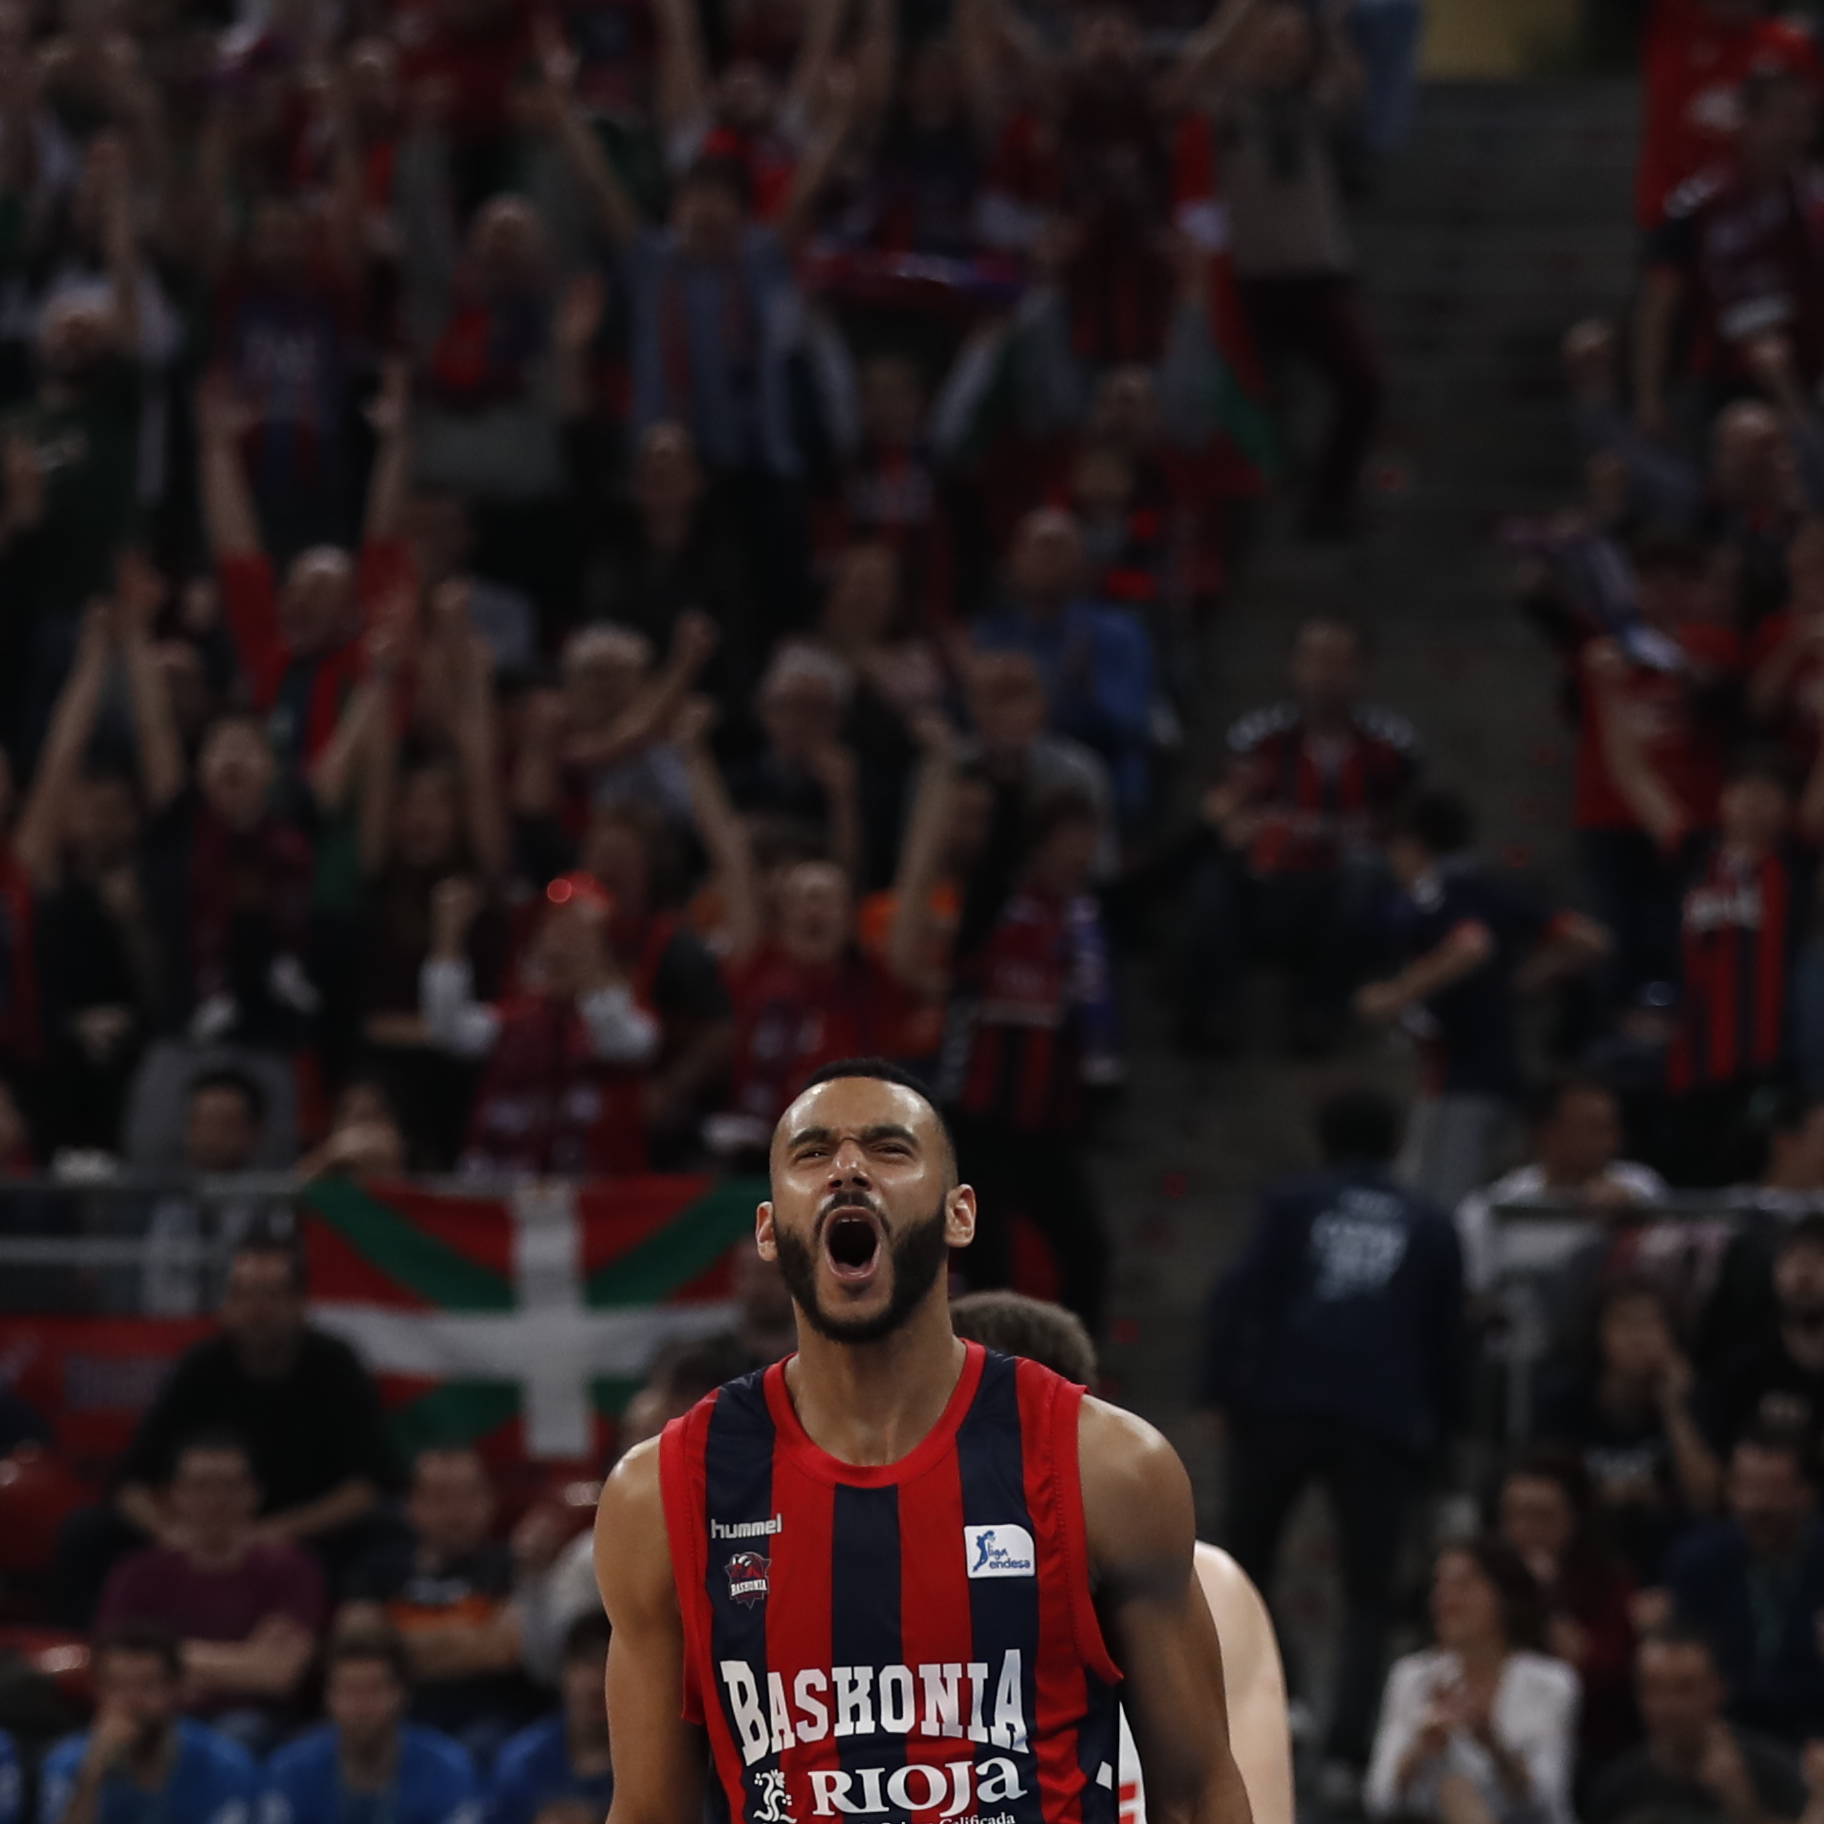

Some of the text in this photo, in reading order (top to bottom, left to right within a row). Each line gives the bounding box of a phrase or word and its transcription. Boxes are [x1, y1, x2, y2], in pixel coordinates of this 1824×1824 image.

[710, 1513, 782, 1539] hummel
[989, 1557, 1031, 1569] endesa
[730, 1579, 768, 1597] BASKONIA
[719, 1648, 1030, 1767] BASKONIA
